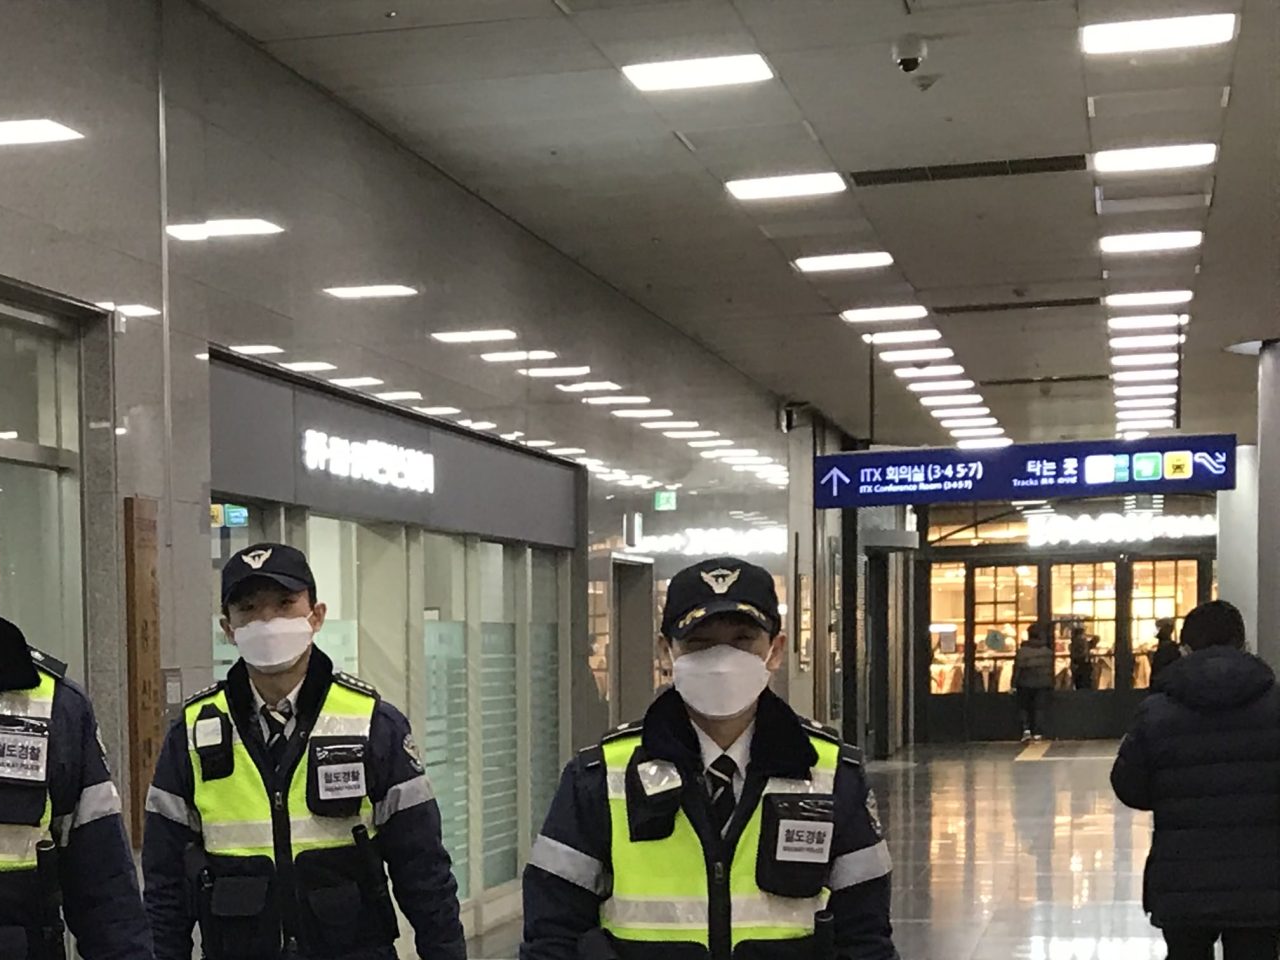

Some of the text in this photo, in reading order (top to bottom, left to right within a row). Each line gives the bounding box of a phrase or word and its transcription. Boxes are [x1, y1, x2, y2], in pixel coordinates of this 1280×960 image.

[860, 467, 882, 482] ITX
[885, 464, 925, 483] 회의실
[1026, 457, 1078, 476] 타는 곳
[1012, 478, 1038, 487] Tracks
[785, 829, 826, 844] 철도경찰
